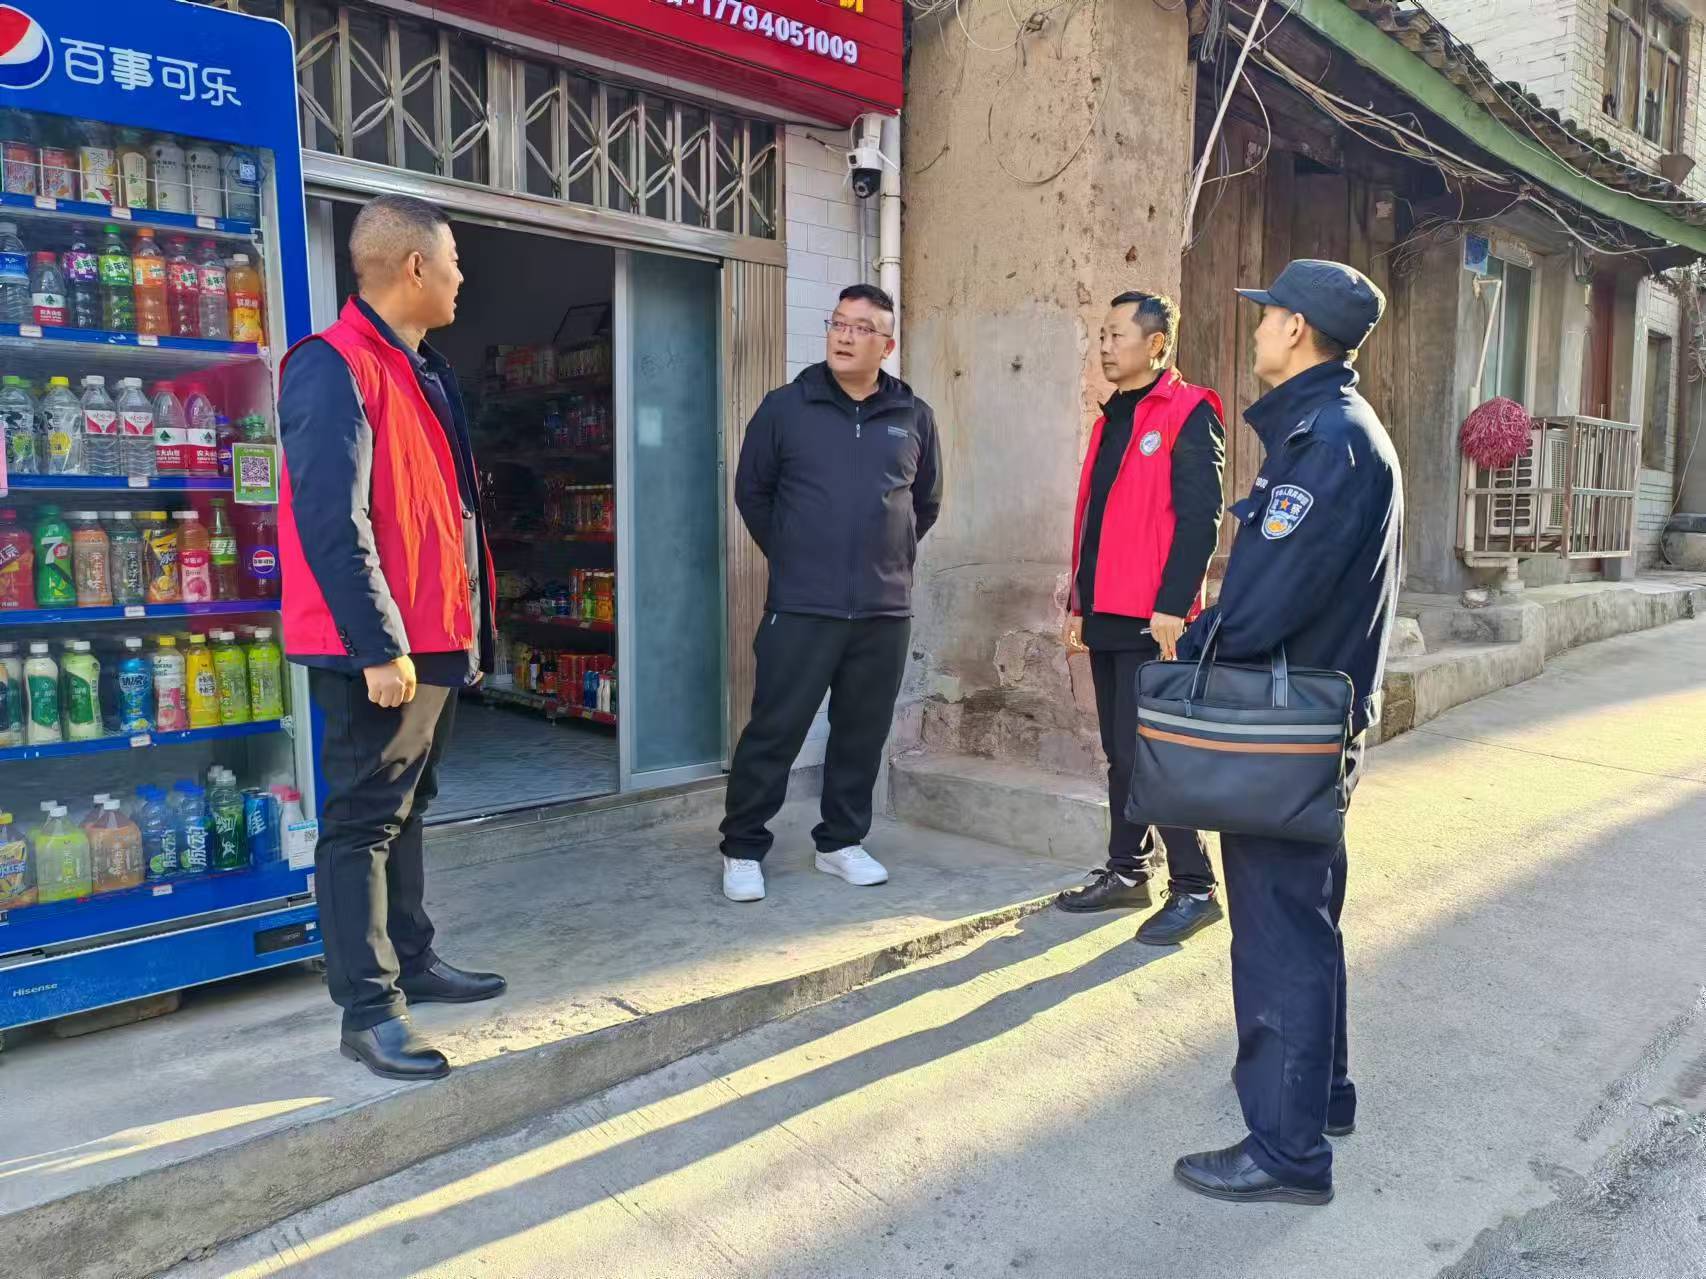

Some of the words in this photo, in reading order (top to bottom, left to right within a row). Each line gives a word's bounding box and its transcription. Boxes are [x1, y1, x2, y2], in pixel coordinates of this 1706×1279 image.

[60, 37, 242, 106] 百事可乐
[13, 983, 58, 997] Hisense
